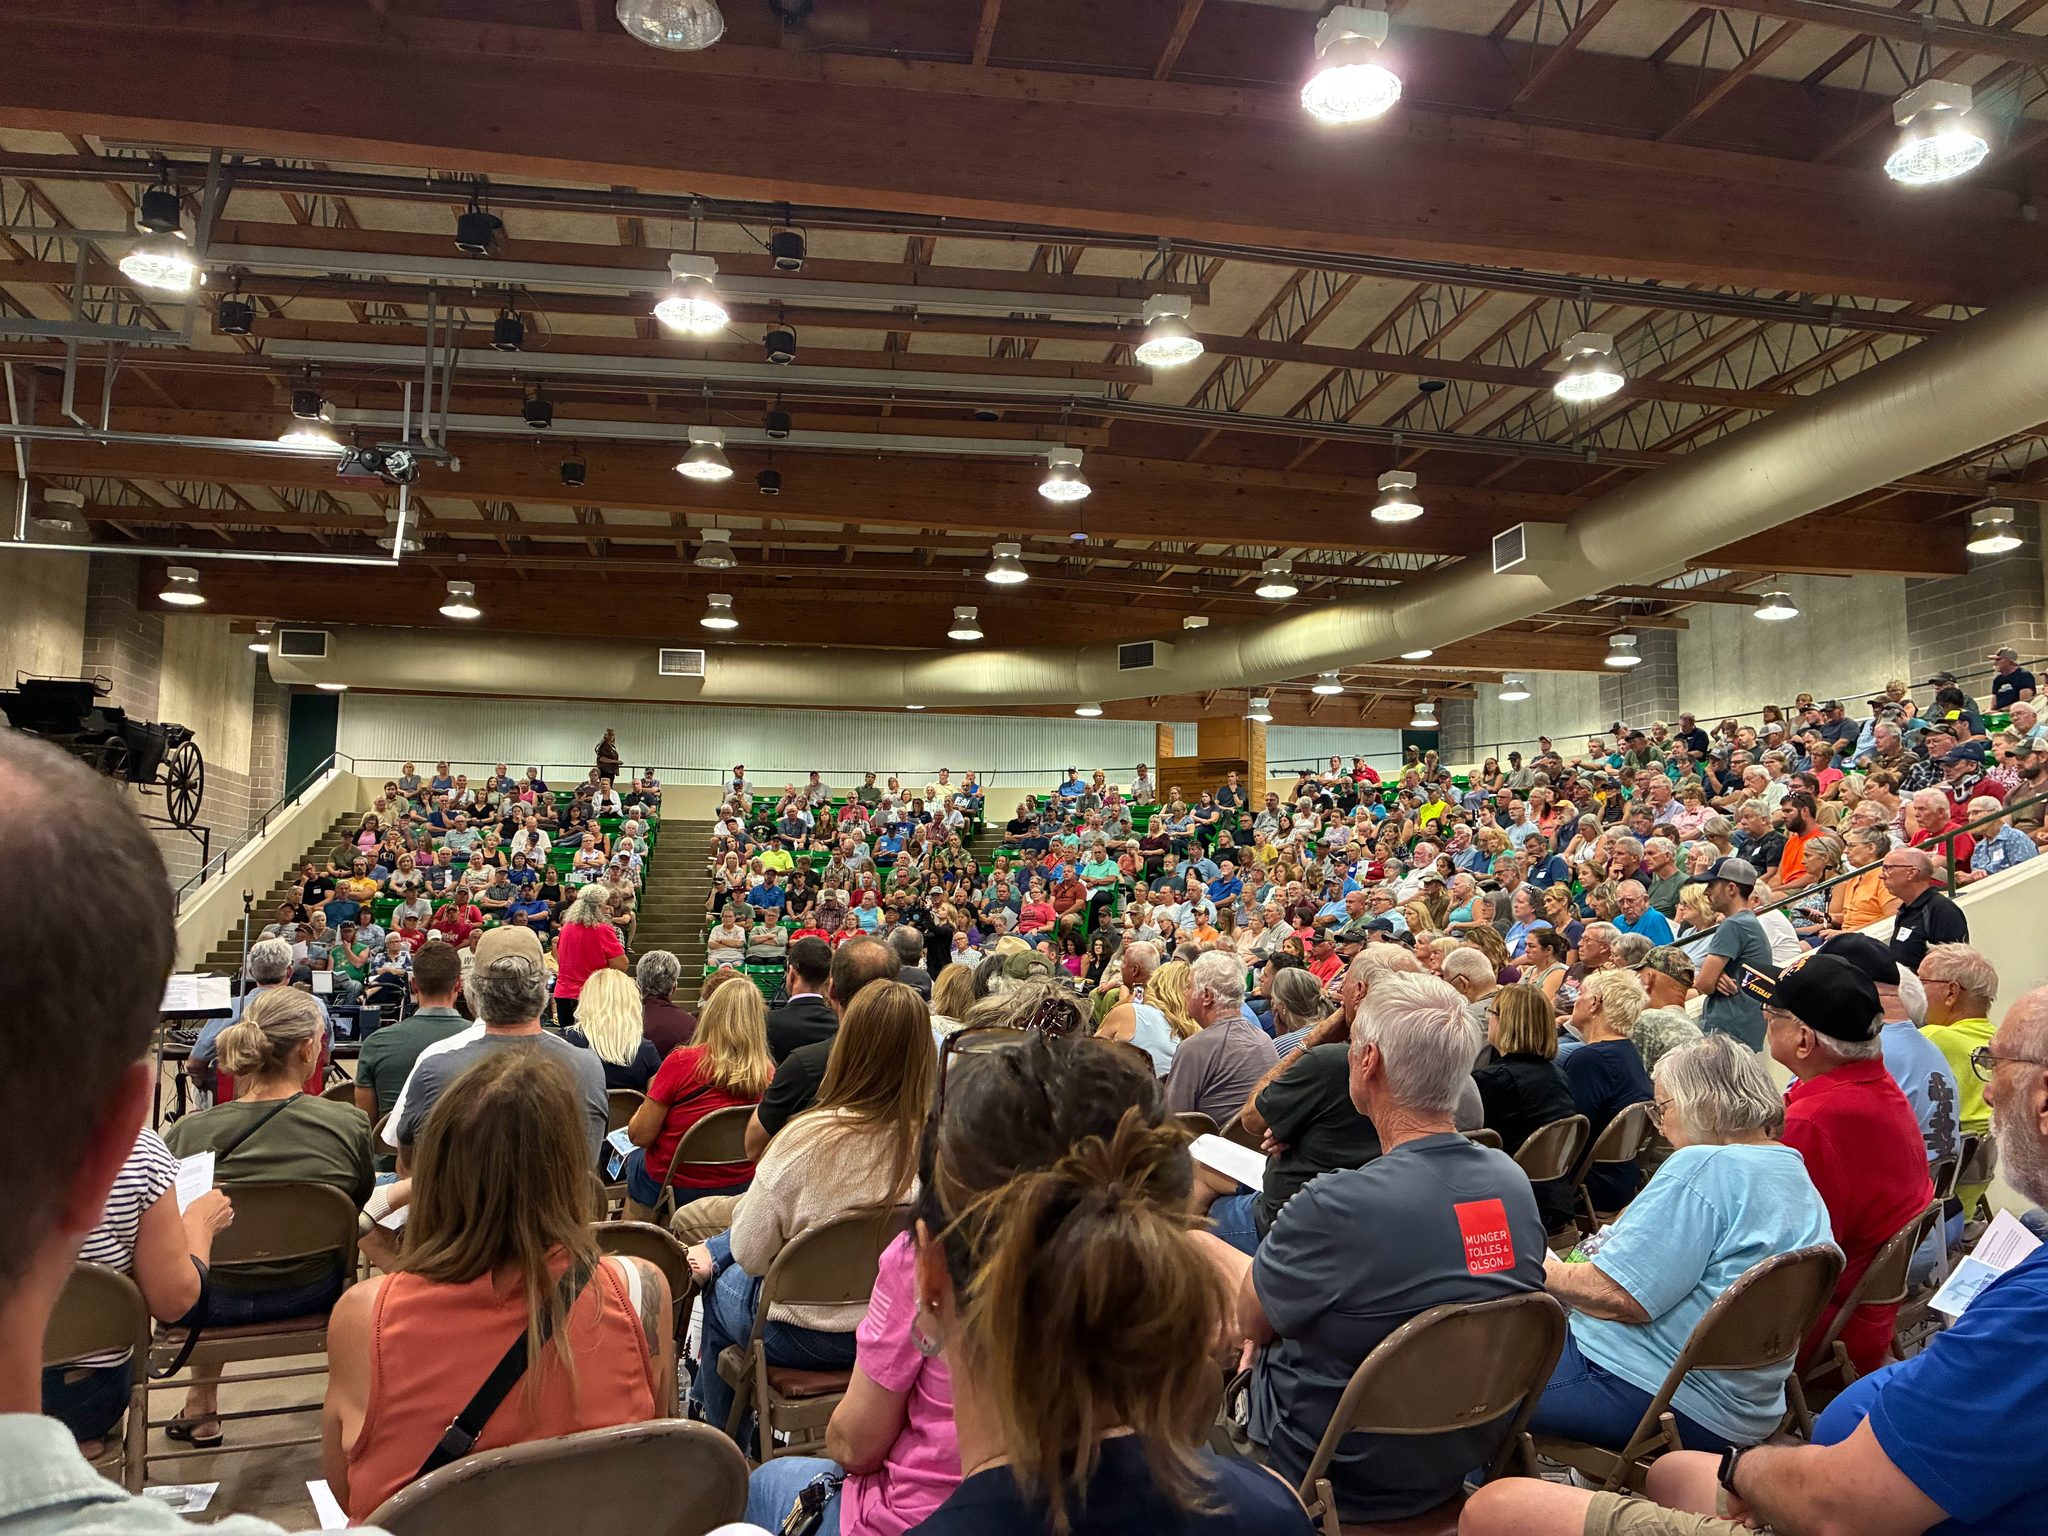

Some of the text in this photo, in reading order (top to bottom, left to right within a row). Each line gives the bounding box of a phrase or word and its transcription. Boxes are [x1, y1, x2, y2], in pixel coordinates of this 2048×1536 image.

[1465, 1231, 1507, 1245] MUNGER
[1468, 1244, 1502, 1258] TOLLES
[1470, 1257, 1503, 1270] OLSON
